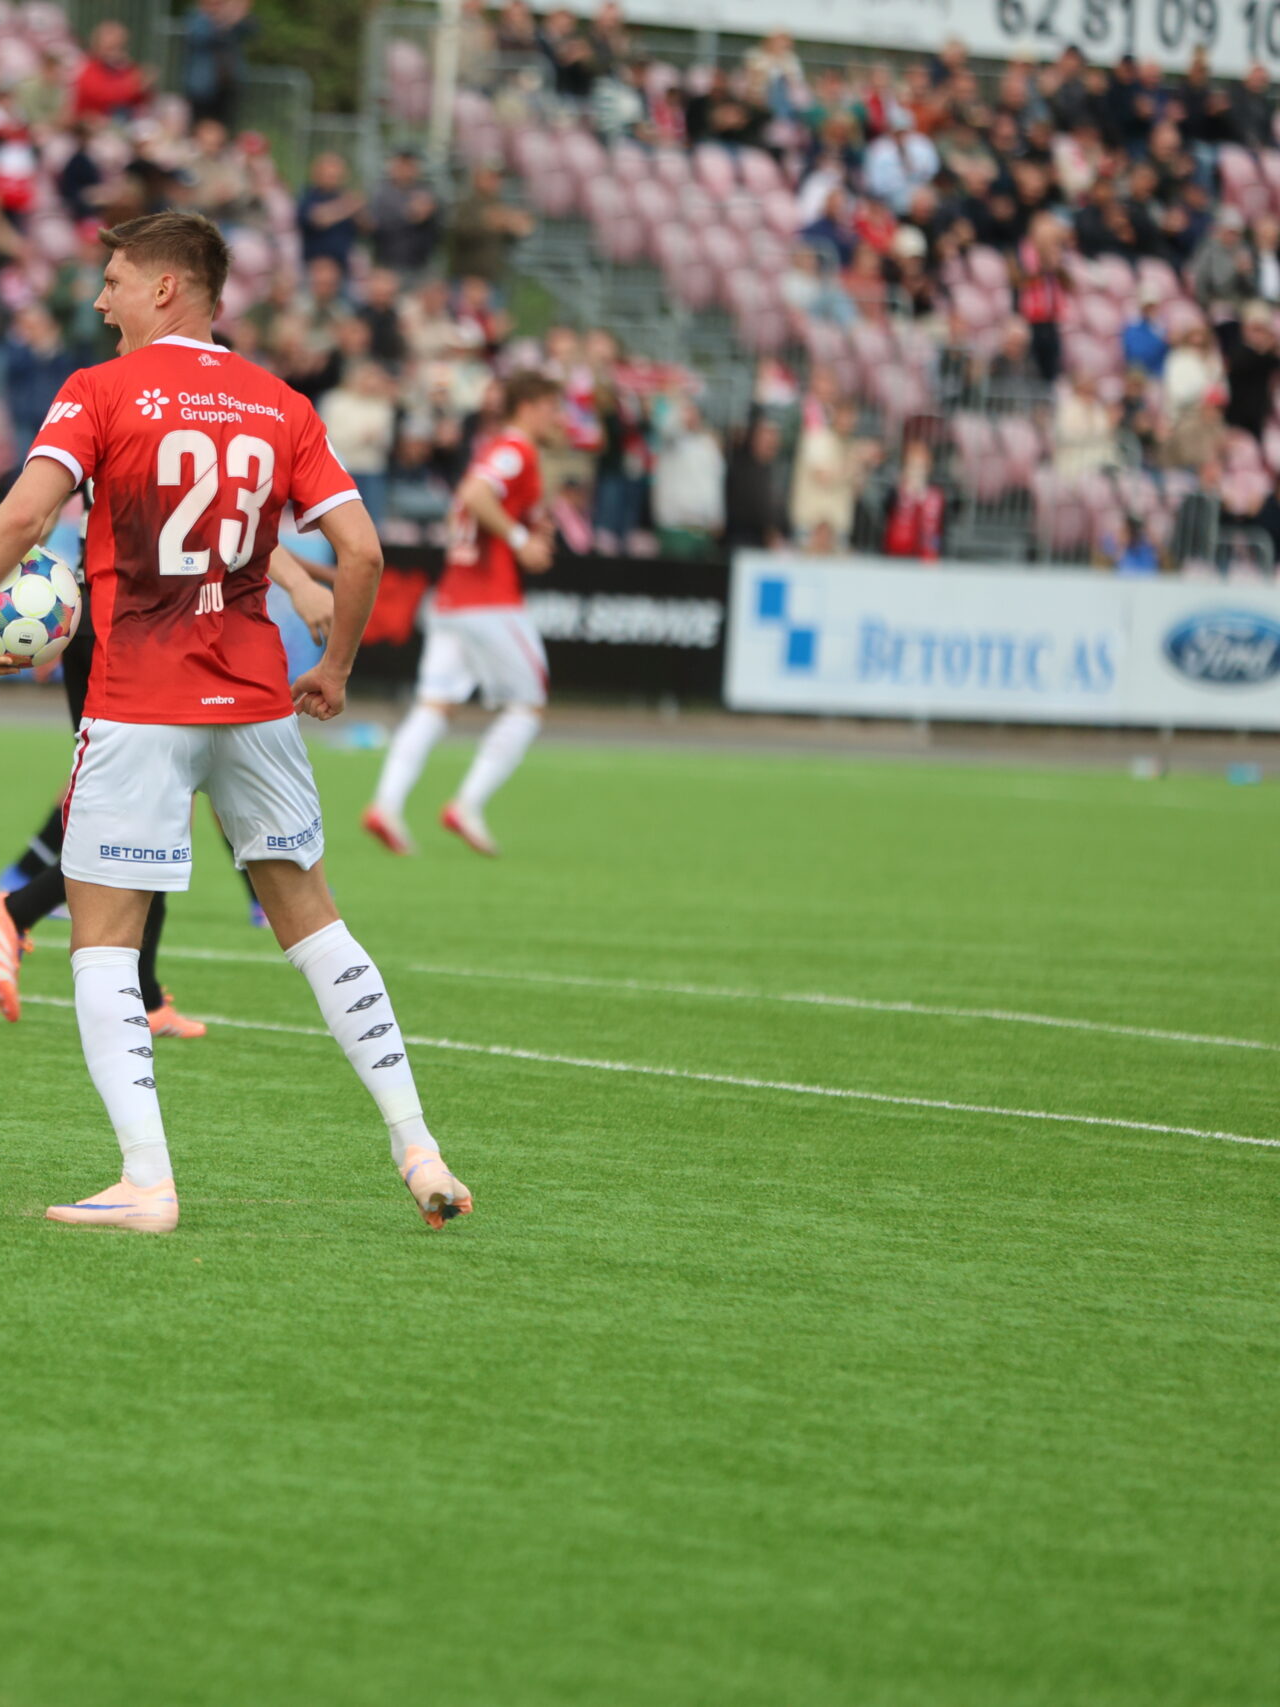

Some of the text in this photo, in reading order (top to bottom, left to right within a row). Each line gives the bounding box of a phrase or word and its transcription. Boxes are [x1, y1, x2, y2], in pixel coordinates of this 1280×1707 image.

[178, 392, 215, 406] Odal
[157, 430, 275, 576] 23
[201, 696, 235, 704] umbro
[100, 845, 166, 860] BETONG
